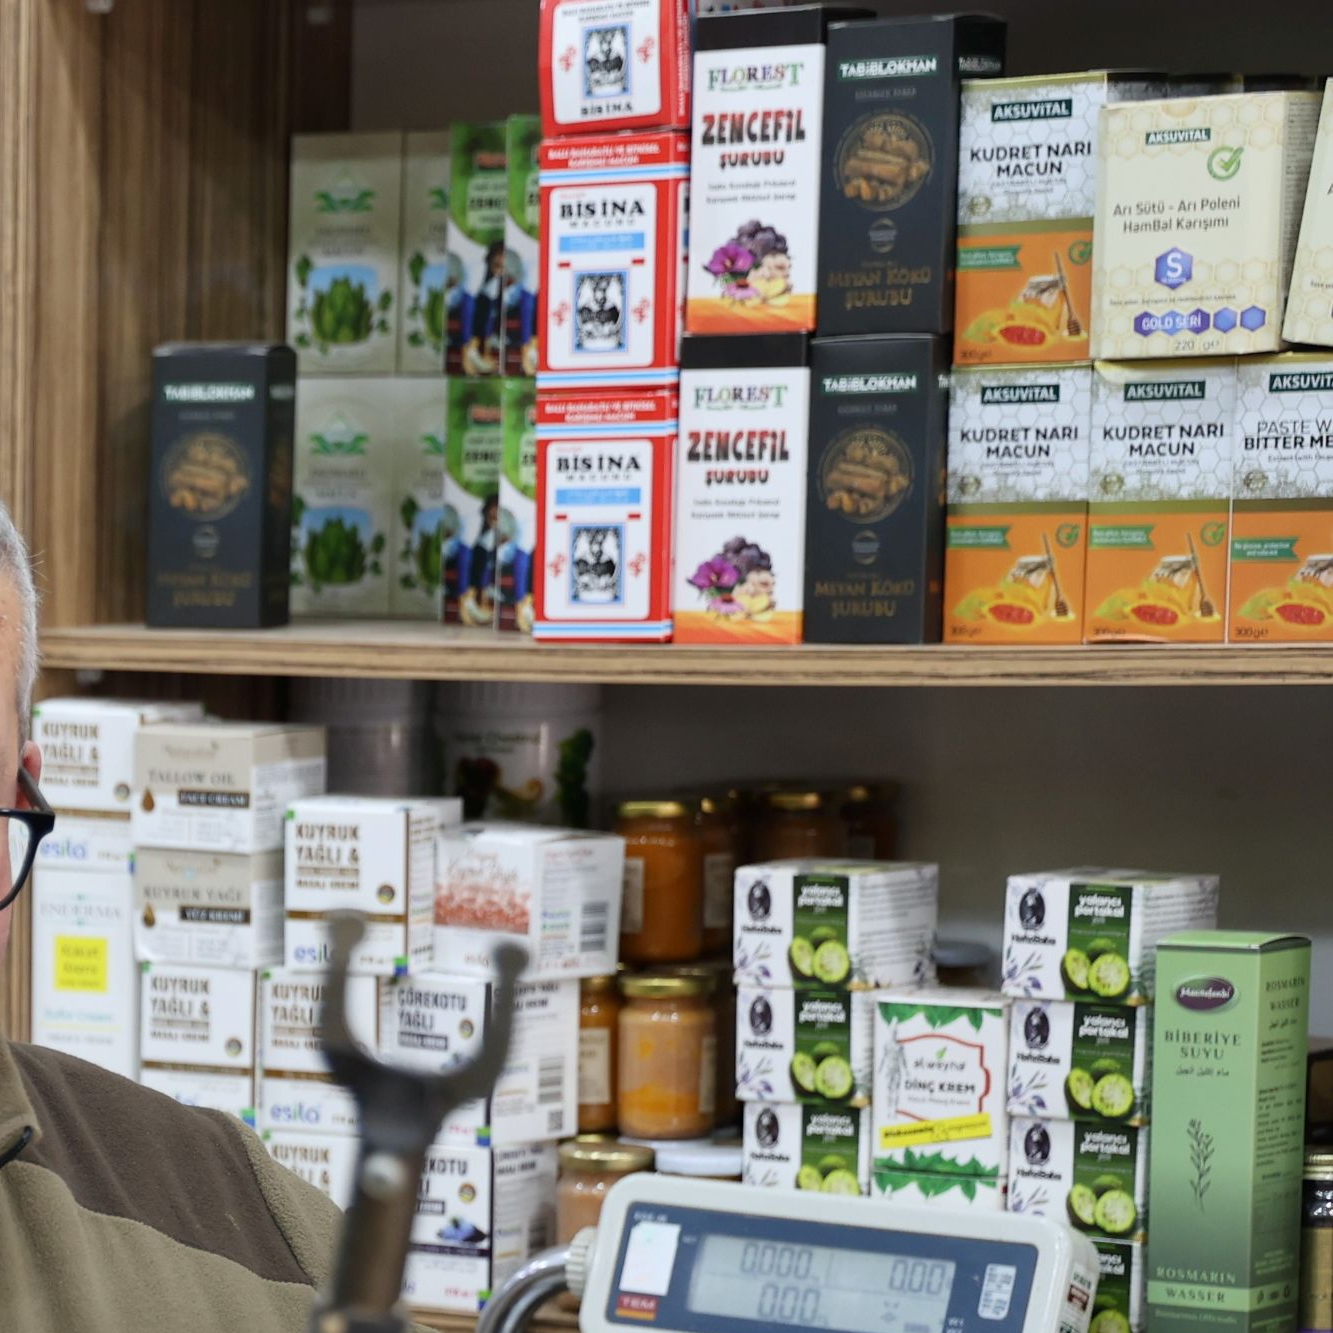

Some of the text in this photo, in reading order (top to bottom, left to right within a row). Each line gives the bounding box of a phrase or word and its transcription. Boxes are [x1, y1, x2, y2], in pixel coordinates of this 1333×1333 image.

[707, 62, 805, 91] FLOREST
[701, 107, 806, 146] ZENCEFİL
[719, 150, 785, 170] ŞURUBU
[970, 141, 1092, 163] KUDRET NARI
[996, 162, 1063, 179] MACUN
[1167, 250, 1184, 279] S
[1141, 314, 1173, 331] GOLD
[1271, 374, 1333, 390] AKSUVİT
[693, 384, 788, 411] FLOREST
[959, 424, 1079, 443] KUDRET NARI
[1102, 423, 1225, 441] KUDRET NARI
[686, 429, 789, 463] ZENCEFİL
[985, 444, 1051, 459] MACUN
[1128, 442, 1195, 458] MACUN
[1244, 434, 1305, 451] BITTER
[705, 469, 769, 487] ŞURUBU
[295, 824, 360, 841] KUYRUK
[296, 845, 343, 863] YAĞLI
[150, 975, 211, 995] KUYRUK
[271, 983, 325, 1002] KUYRU
[151, 996, 192, 1016] YAĞLI
[1164, 1029, 1242, 1048] BİBERİYE
[1179, 1046, 1225, 1061] SUYU
[1156, 1265, 1237, 1284] ROSMARIN
[1165, 1287, 1226, 1303] WASSER
